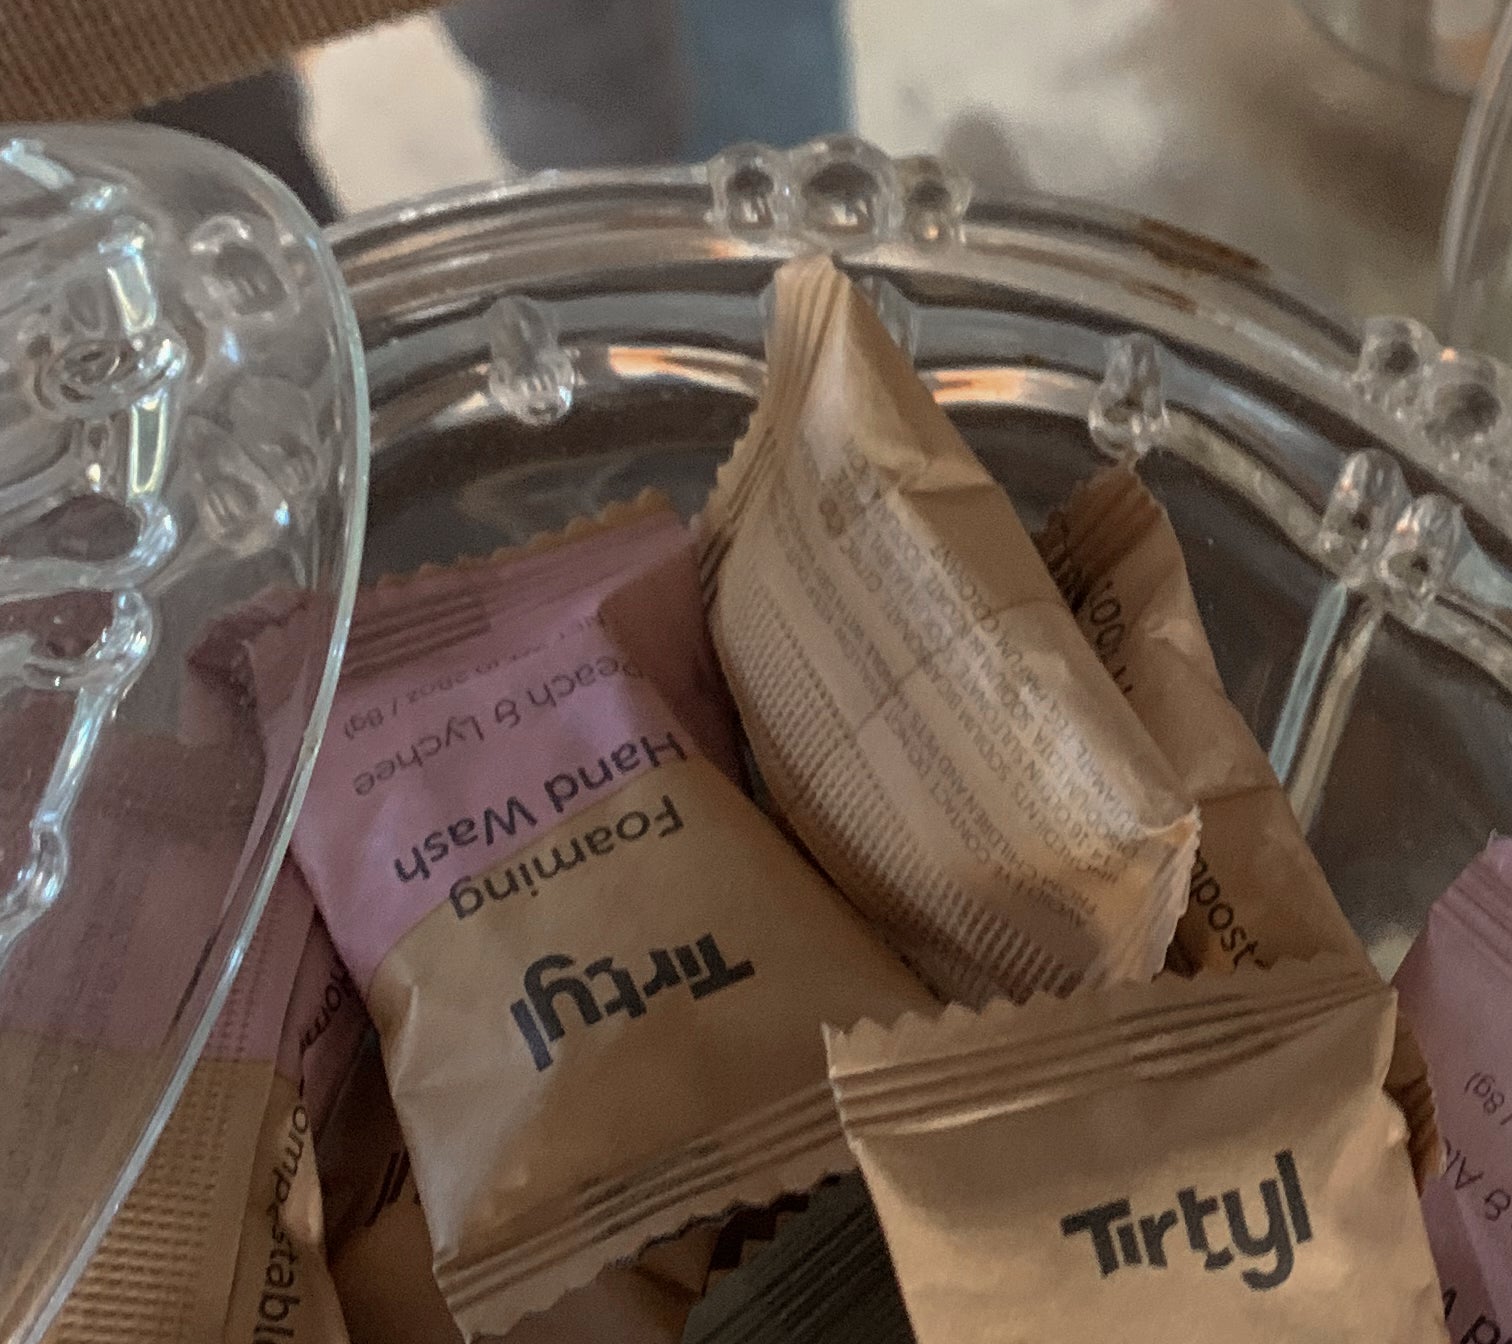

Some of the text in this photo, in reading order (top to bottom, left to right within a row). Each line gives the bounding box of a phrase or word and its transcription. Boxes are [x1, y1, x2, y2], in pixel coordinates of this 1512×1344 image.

[352, 714, 486, 797] Lychee
[493, 698, 522, 730] &
[393, 731, 688, 884] Hand Wash
[449, 794, 685, 920] Foaming
[510, 933, 757, 1072] Tirtyl
[1463, 1070, 1506, 1116] 8g)
[1061, 1149, 1313, 1291] Tirtyl
[1483, 1188, 1512, 1223] &
